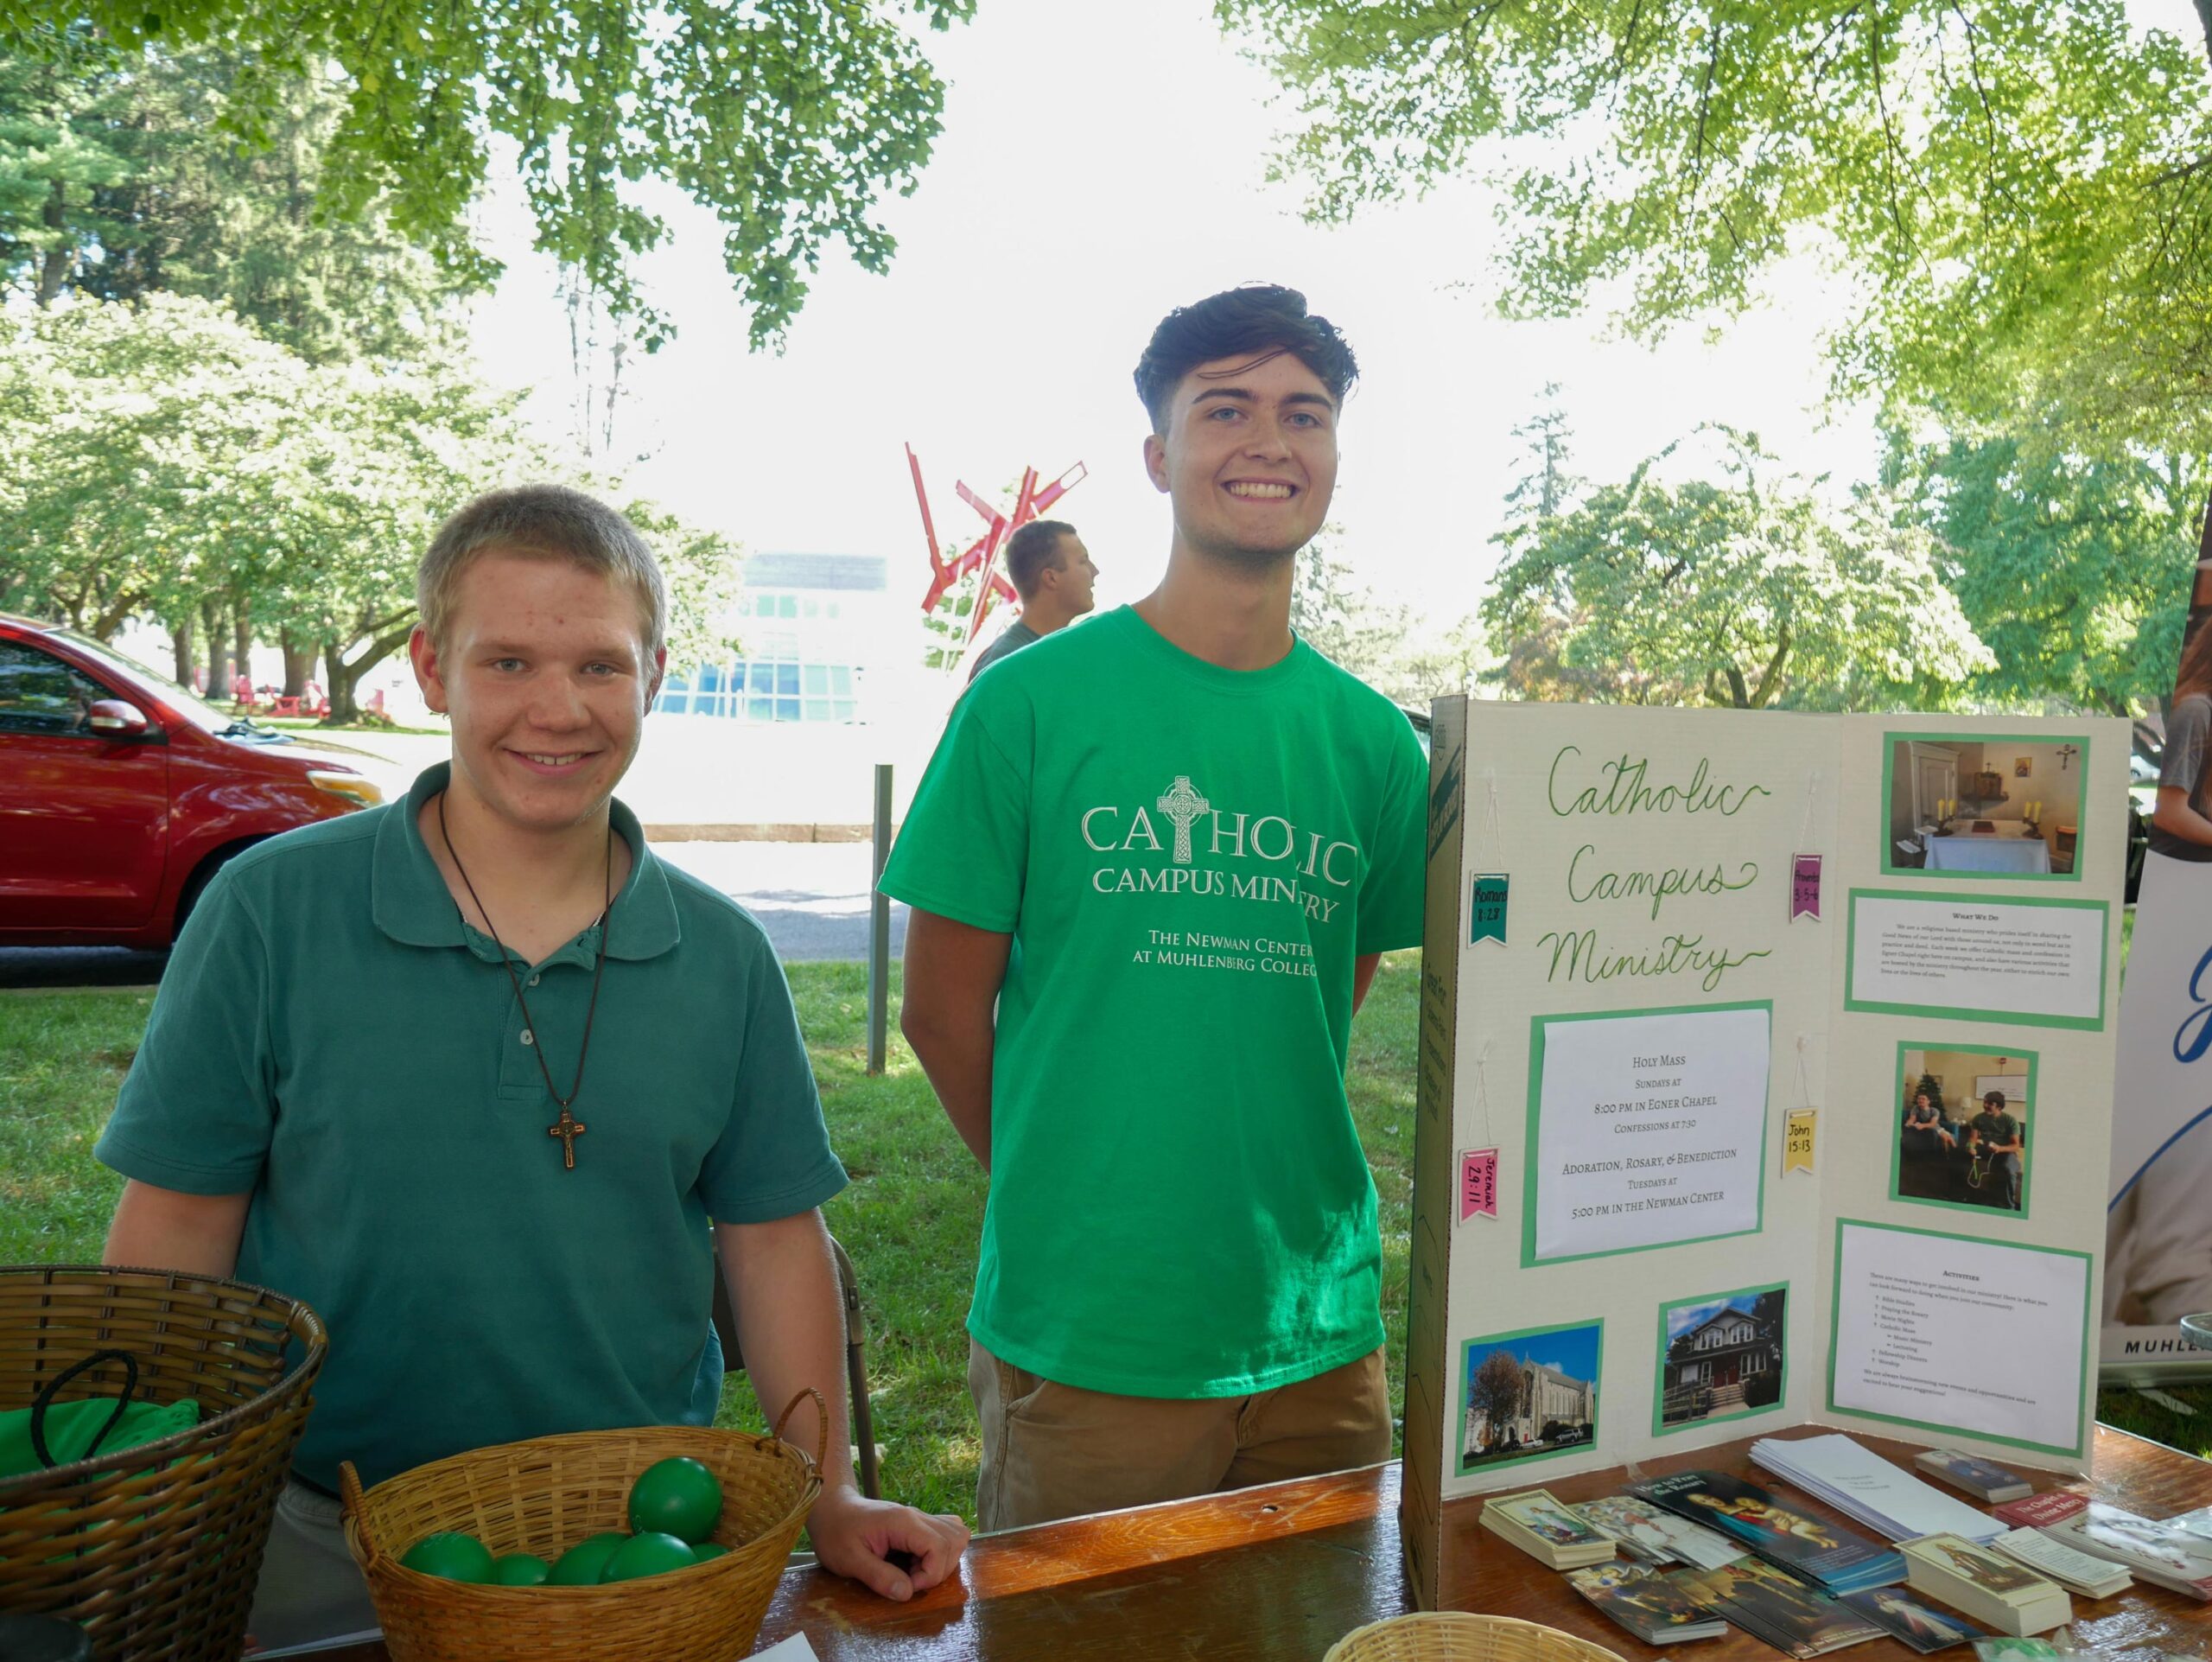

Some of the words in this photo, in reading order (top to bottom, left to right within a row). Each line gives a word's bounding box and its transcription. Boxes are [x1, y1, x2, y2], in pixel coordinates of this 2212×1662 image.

[1548, 746, 1771, 816] Catholic
[1092, 868, 1225, 895] CAMPUS
[1568, 844, 1758, 920] Campus
[1474, 887, 1508, 903] Romans
[1478, 907, 1500, 922] 8:28
[1148, 930, 1180, 946] THE
[1186, 933, 1249, 951] NEWMAN
[1133, 950, 1152, 963] AT
[1157, 950, 1255, 971] MUHLENBERG
[1536, 929, 1772, 991] Ministry
[1632, 1056, 1658, 1068] HOLY
[1660, 1054, 1687, 1067] MASS
[1635, 1079, 1670, 1089] SUNDAYS
[1594, 1104, 1617, 1114] 8:00
[1618, 1103, 1632, 1112] PM
[1635, 1102, 1646, 1111] IN
[1648, 1098, 1680, 1111] EGNER
[1681, 1096, 1718, 1107] CHAPEL
[1614, 1121, 1669, 1134] CONFESSIONS
[1788, 1124, 1810, 1137] John
[1789, 1139, 1811, 1152] 15:13
[1562, 1161, 1624, 1175] ADORATION,
[1625, 1156, 1665, 1169] ROSARY,
[1666, 1153, 1676, 1165] &
[1677, 1149, 1738, 1164] BENEDICTION
[1468, 1165, 1481, 1202] 29:11
[1484, 1157, 1496, 1209] Jeremiah
[1627, 1178, 1667, 1190] TUESDAYS
[1668, 1177, 1678, 1186] AT
[1572, 1207, 1593, 1219] 5:00
[1596, 1206, 1610, 1216] PM
[1611, 1204, 1623, 1214] IN
[1625, 1201, 1644, 1213] THE
[1646, 1195, 1688, 1210] NEWMAN
[1690, 1191, 1725, 1204] CENTER
